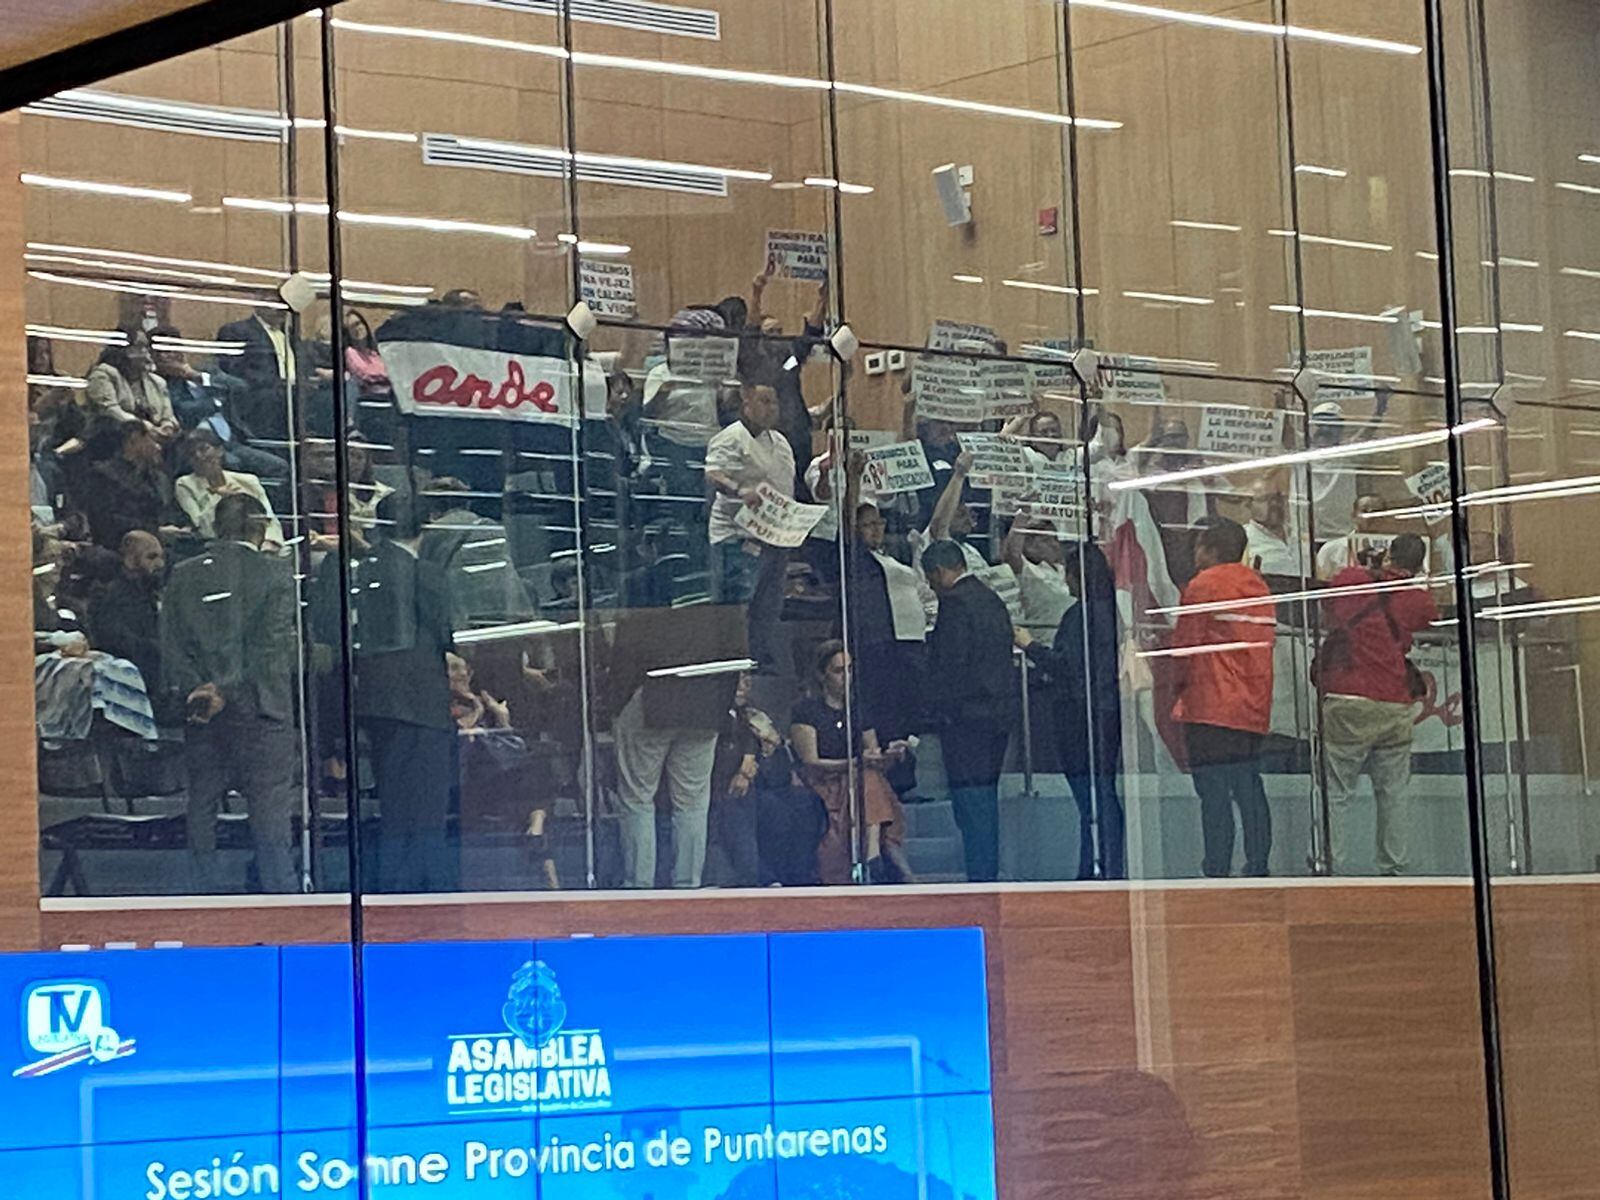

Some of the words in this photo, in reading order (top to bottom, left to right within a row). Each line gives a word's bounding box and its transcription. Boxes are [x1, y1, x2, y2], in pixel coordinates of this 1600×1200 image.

[588, 300, 603, 312] DE
[413, 360, 559, 414] ande
[1206, 430, 1214, 438] A
[1216, 430, 1230, 439] LA
[36, 990, 91, 1033] TV
[447, 1033, 606, 1073] ASAMBLEA
[447, 1066, 612, 1105] LEGISLATIVA
[145, 1151, 280, 1200] Sesión
[465, 1132, 635, 1181] Provincia
[644, 1129, 692, 1168] de
[704, 1122, 888, 1164] Puntarenas
